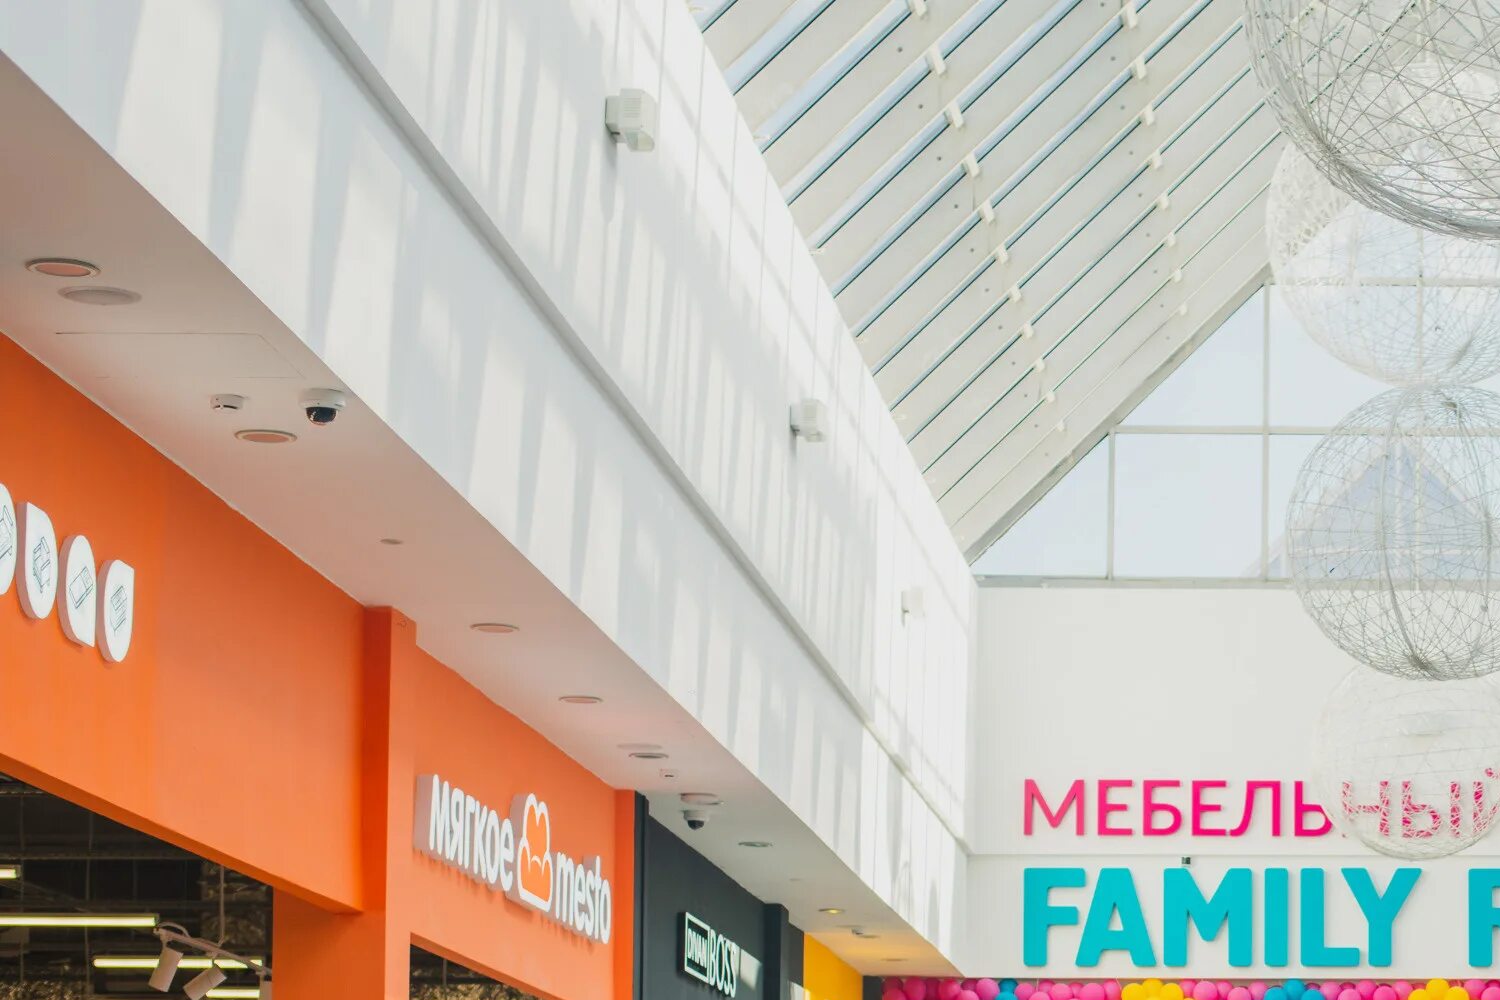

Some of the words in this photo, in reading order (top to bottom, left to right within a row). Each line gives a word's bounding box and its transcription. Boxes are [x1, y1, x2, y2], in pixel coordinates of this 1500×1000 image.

[554, 855, 612, 945] mesto
[1023, 867, 1421, 967] FAMILY
[687, 926, 708, 969] DIVAN
[709, 929, 737, 998] BOSS
